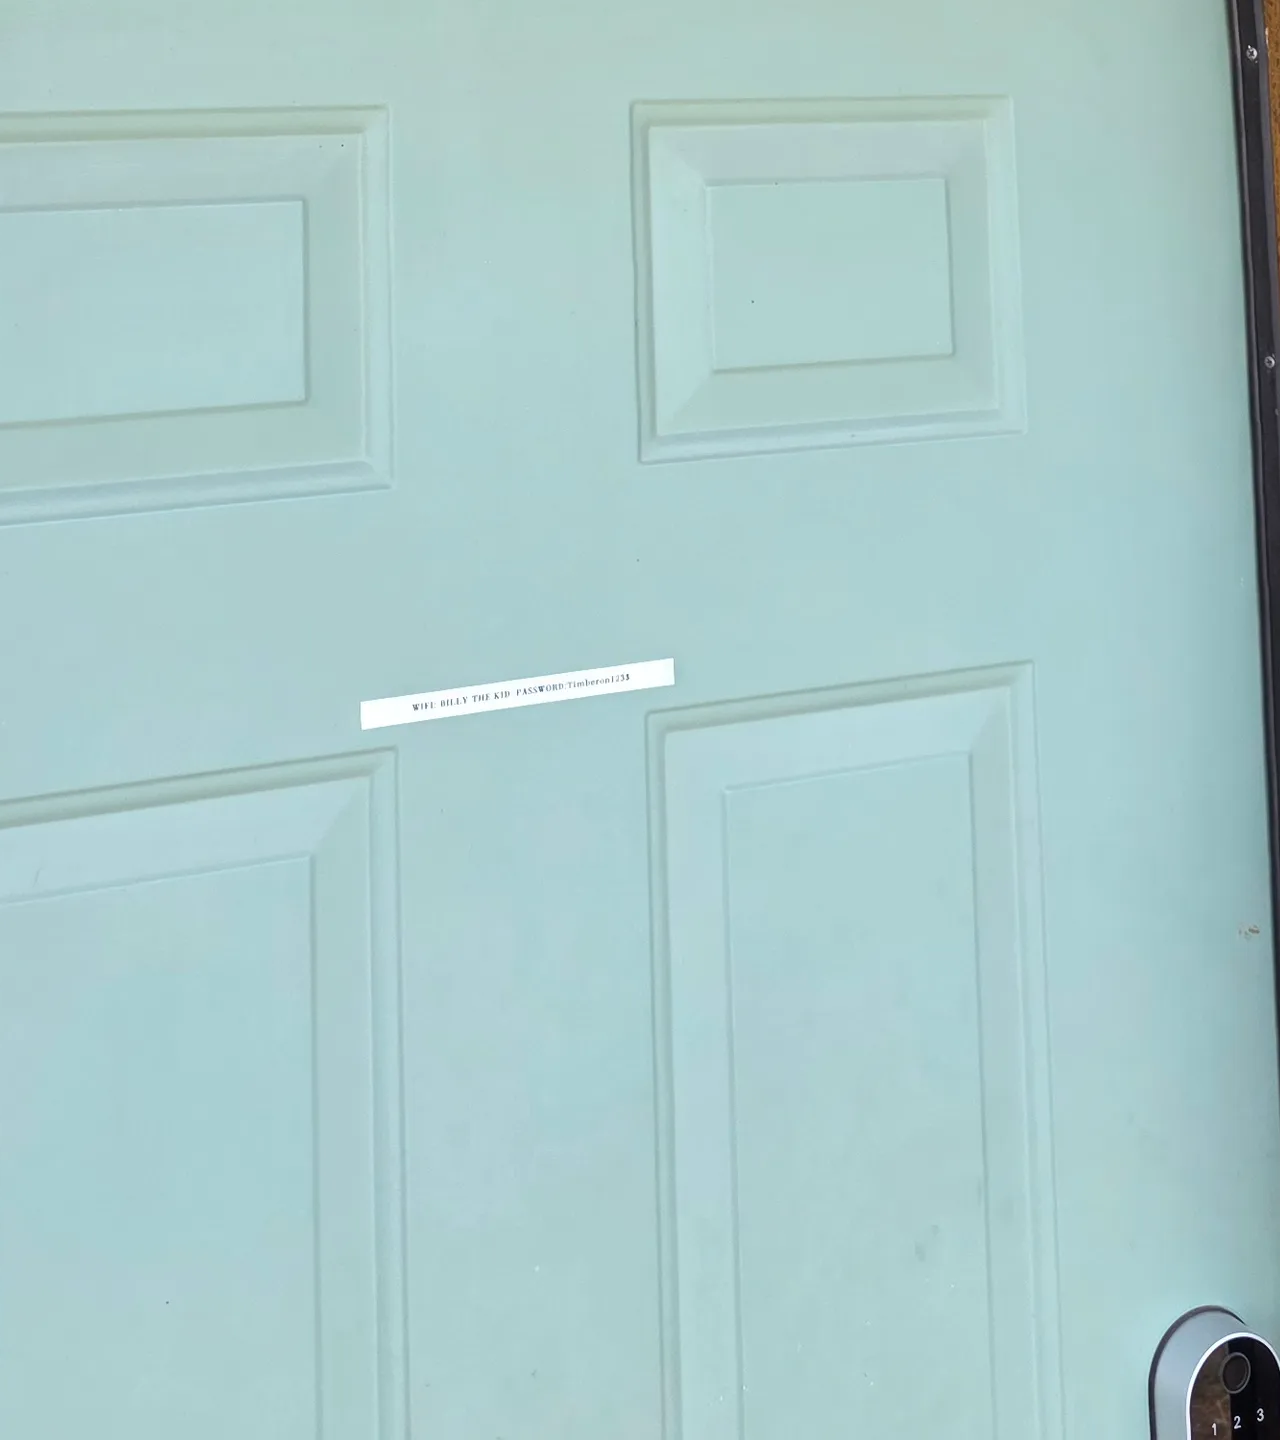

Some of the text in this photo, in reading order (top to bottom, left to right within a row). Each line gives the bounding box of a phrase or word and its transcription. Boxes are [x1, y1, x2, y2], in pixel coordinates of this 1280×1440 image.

[440, 696, 468, 707] BILLY
[472, 693, 491, 702] THE
[494, 690, 510, 700] KID
[1211, 1408, 1264, 1436] 1 2 3
